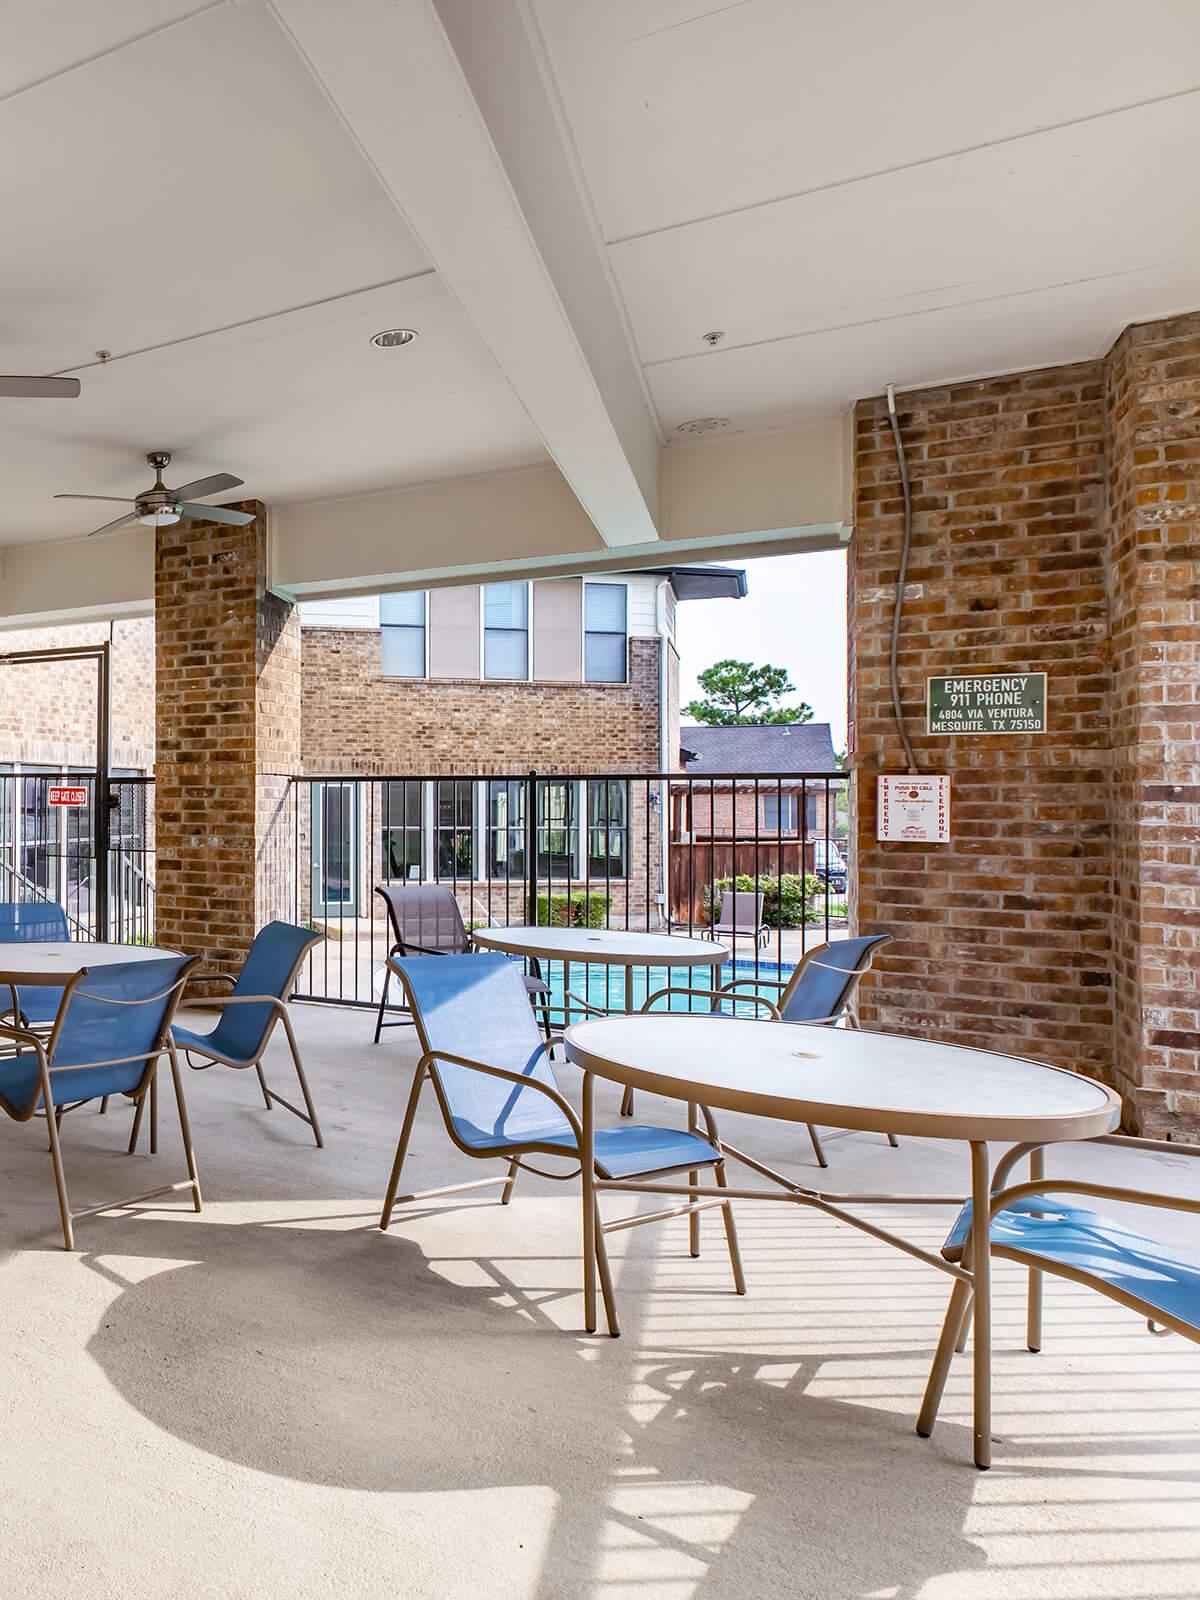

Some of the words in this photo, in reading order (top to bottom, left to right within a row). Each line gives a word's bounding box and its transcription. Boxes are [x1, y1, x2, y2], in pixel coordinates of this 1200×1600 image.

[944, 678, 1028, 693] EMERGENCY
[950, 694, 970, 706] 911
[976, 692, 1022, 705] PHONE
[939, 710, 963, 719] 4804
[967, 709, 984, 718] VIA
[988, 708, 1034, 718] VENTURA
[992, 720, 1005, 730] TX
[1010, 720, 1041, 729] 75150
